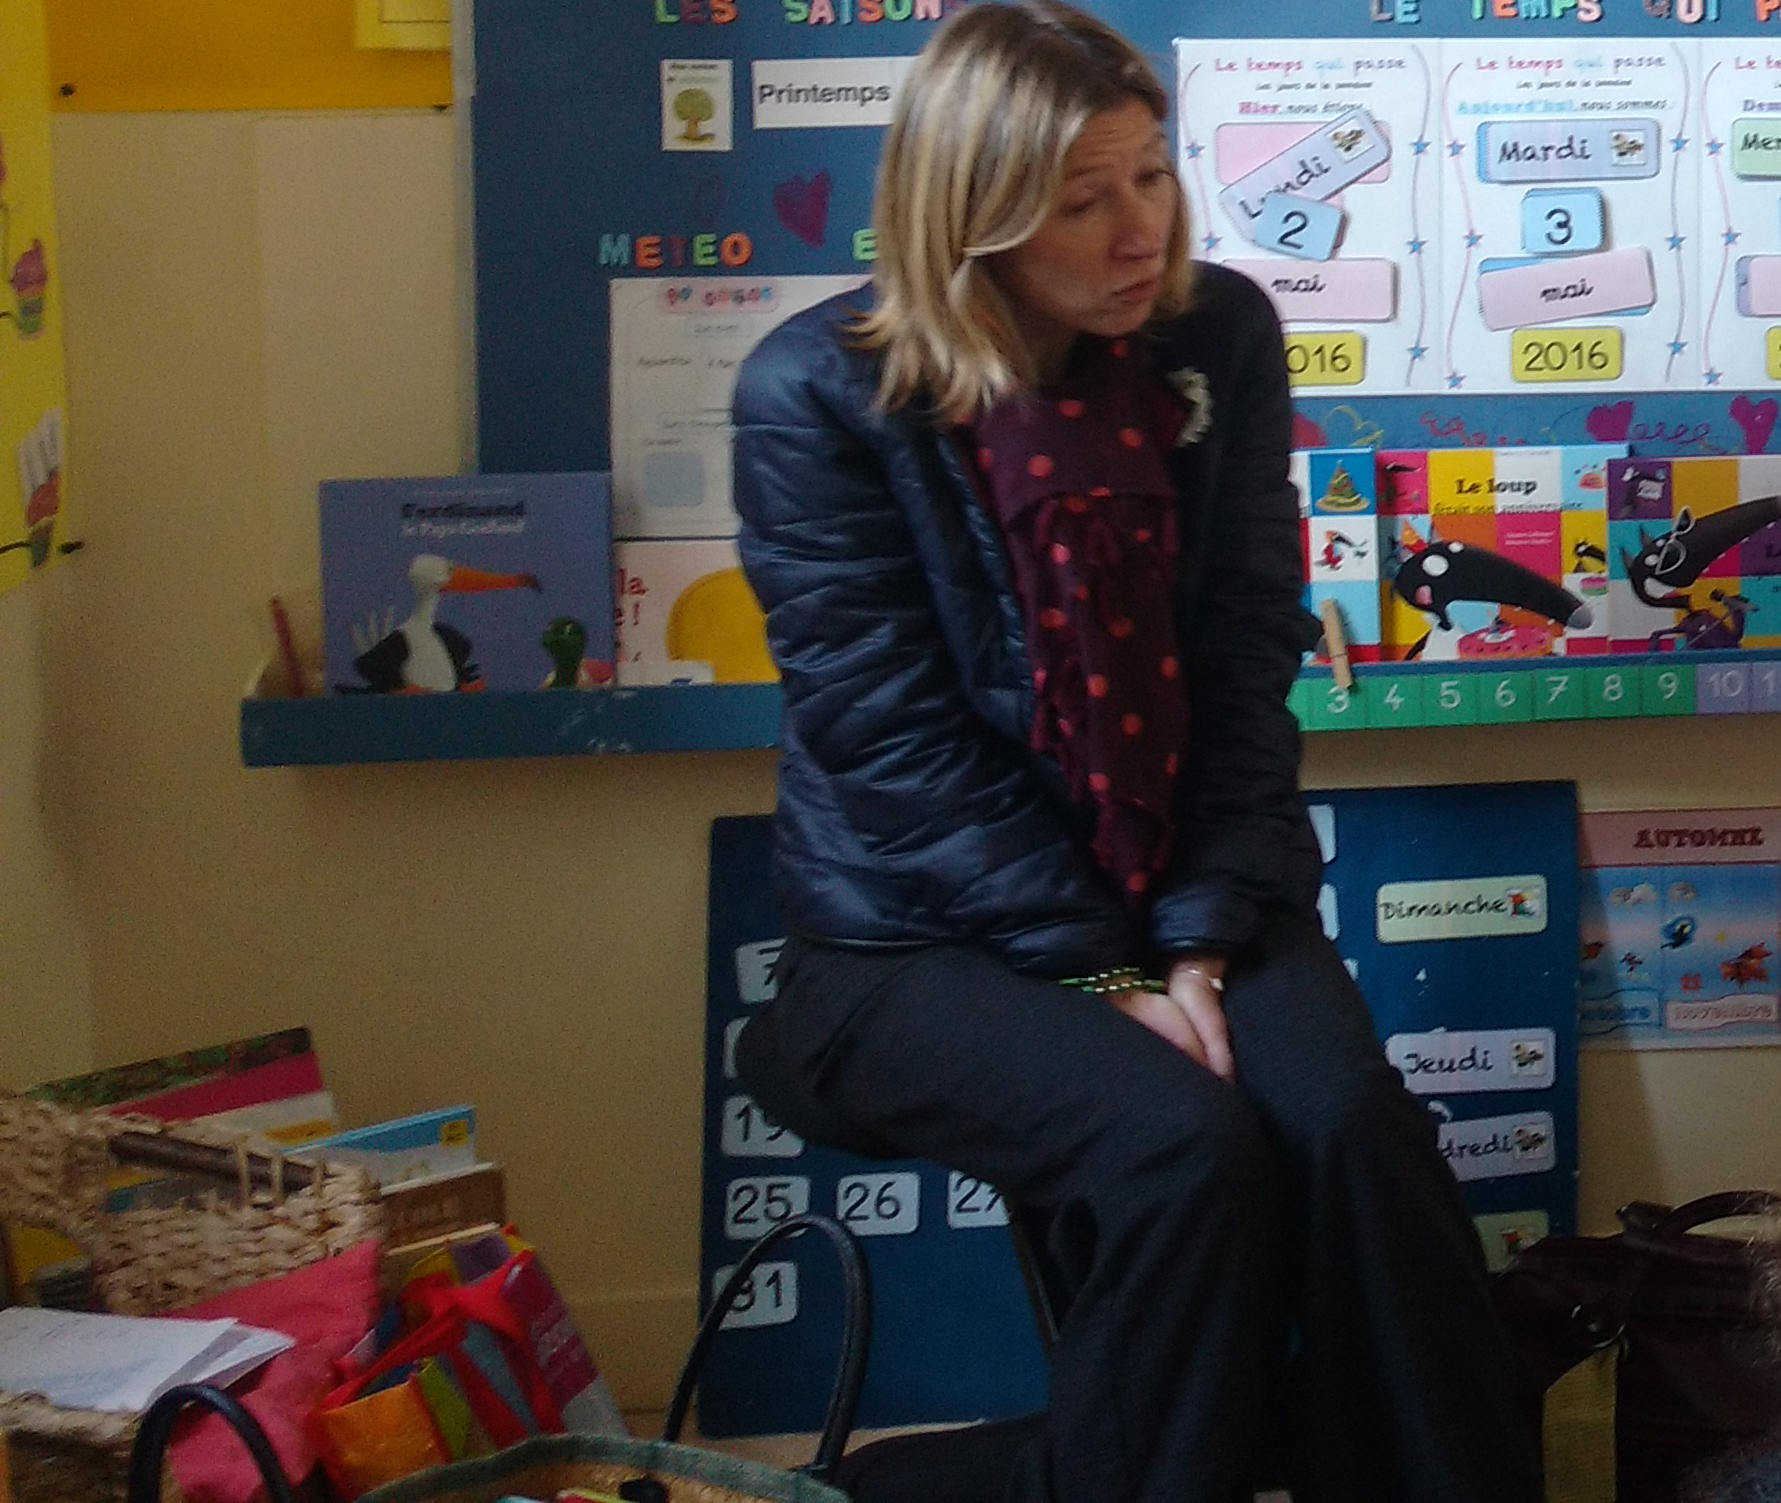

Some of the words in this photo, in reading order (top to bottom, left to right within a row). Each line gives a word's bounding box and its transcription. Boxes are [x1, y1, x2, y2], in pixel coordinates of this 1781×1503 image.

[759, 82, 891, 107] Printemps
[1499, 134, 1592, 163] Mardi
[1277, 210, 1309, 249] 2
[1545, 208, 1573, 246] 3
[599, 232, 753, 269] METEO
[1271, 275, 1326, 295] mai
[1539, 277, 1594, 303] mai
[1523, 338, 1609, 372] 2016
[1455, 478, 1481, 495] Le
[1486, 478, 1538, 496] loup
[1383, 685, 1405, 712] 4
[1440, 681, 1463, 709] 5
[1495, 679, 1518, 707] 6
[1545, 676, 1570, 702] 7
[1602, 674, 1624, 702] 8
[1657, 672, 1680, 698] 9
[1707, 669, 1744, 697] 10
[1633, 826, 1766, 849] AUTOMNE
[1381, 894, 1509, 921] Dimanche
[1402, 1049, 1493, 1075] Jeudi
[1441, 1134, 1514, 1160] dredi
[731, 1182, 791, 1223] 25
[842, 1181, 901, 1220] 26
